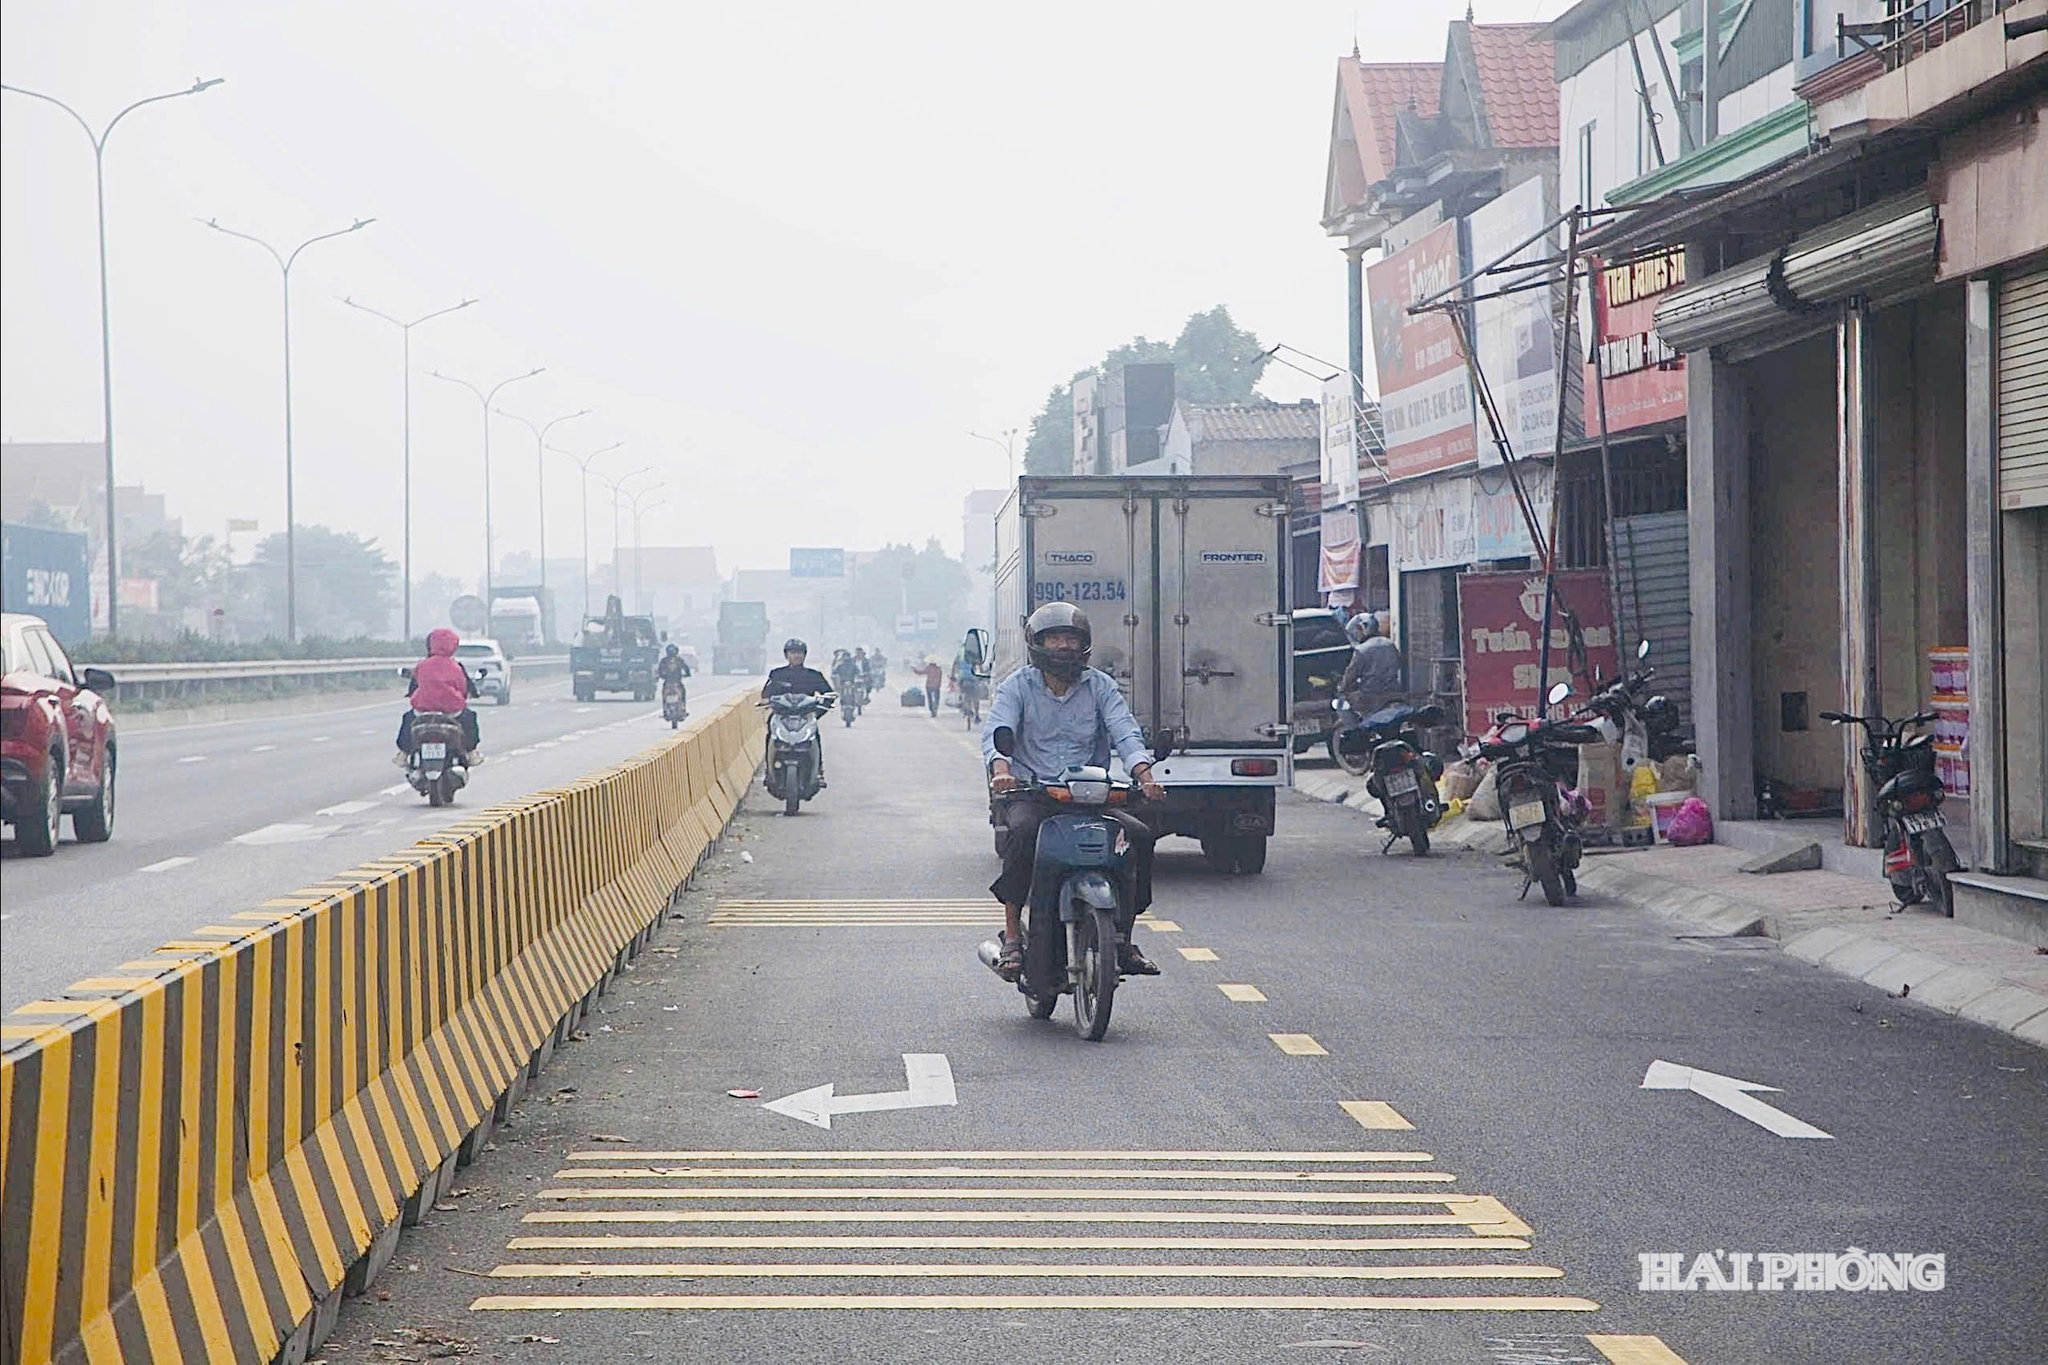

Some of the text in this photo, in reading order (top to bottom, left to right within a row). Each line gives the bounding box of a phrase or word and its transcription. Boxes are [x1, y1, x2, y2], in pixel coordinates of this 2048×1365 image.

[1051, 553, 1093, 563] THACO
[1203, 553, 1263, 562] FRONTIER
[1034, 581, 1126, 600] 99C-123.54
